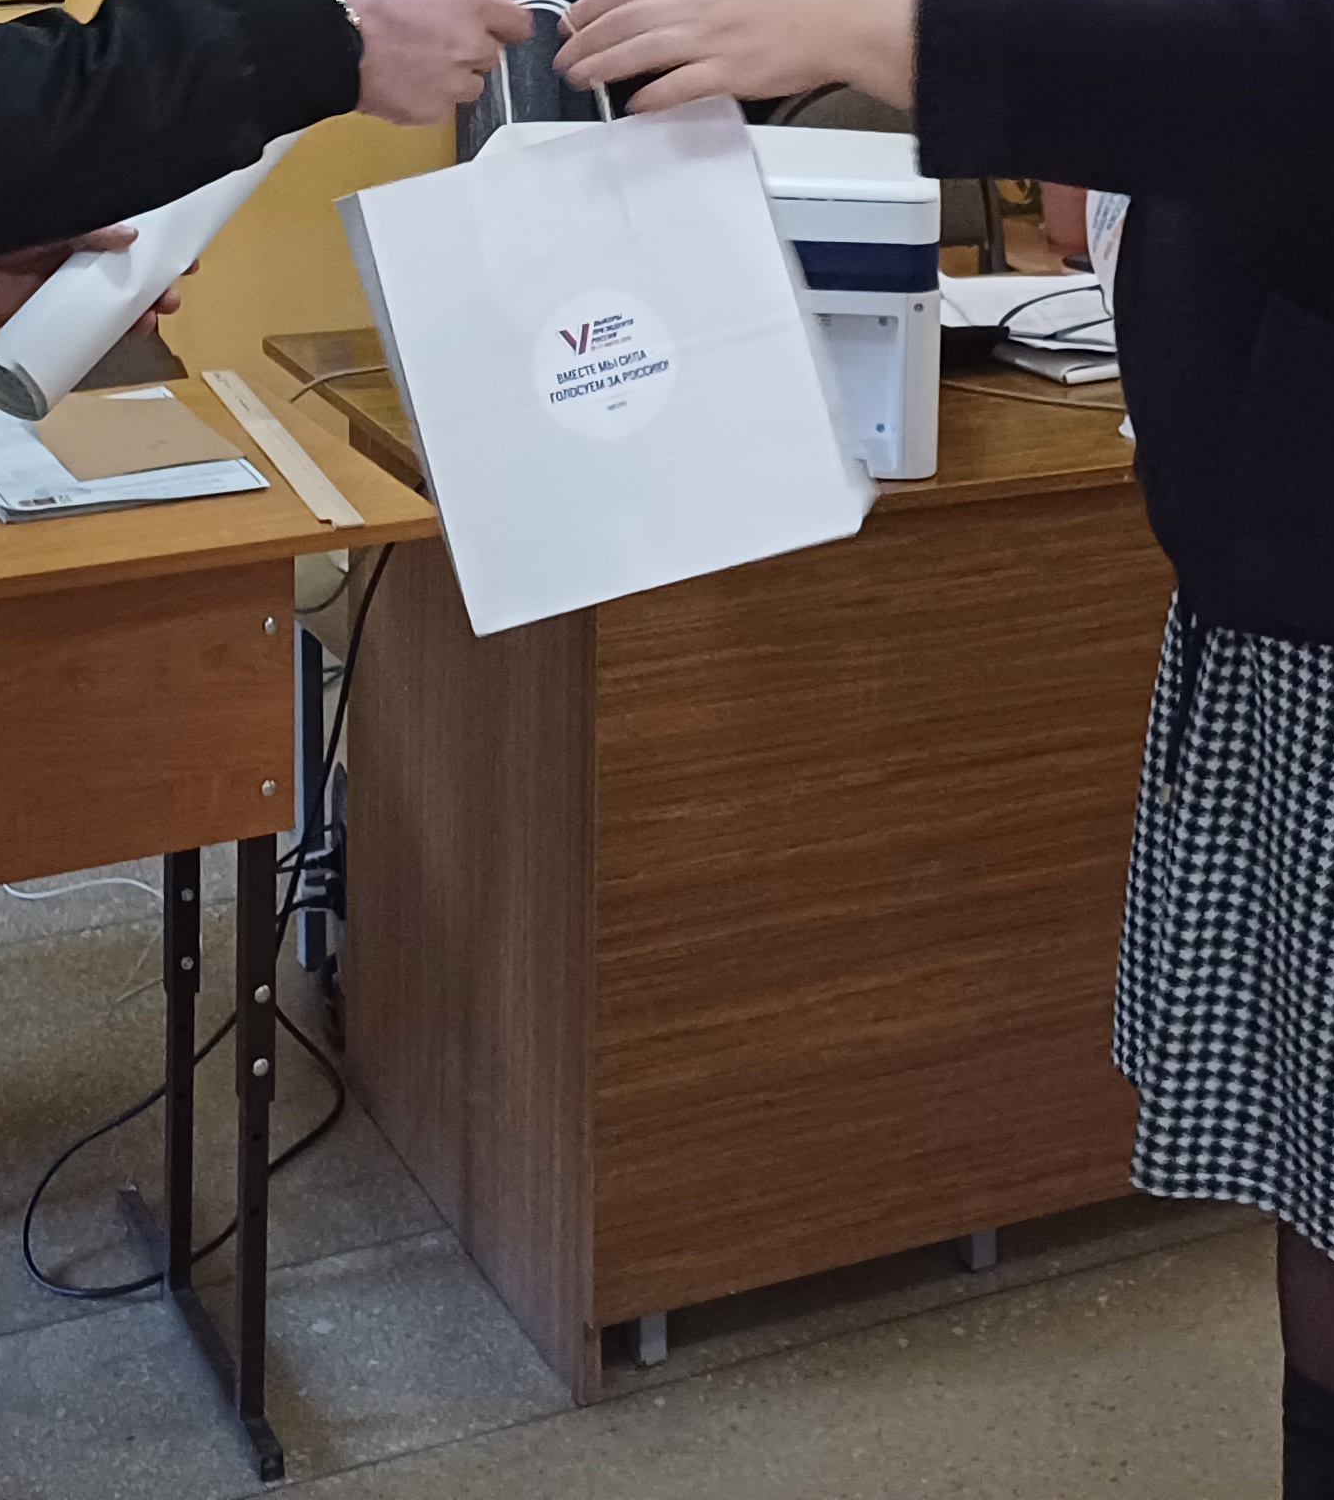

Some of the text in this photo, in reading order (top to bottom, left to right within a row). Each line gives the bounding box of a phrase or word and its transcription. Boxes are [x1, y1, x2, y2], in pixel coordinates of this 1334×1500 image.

[556, 363, 597, 385] ВМЕСТЕ
[598, 358, 619, 373] МЫ
[549, 379, 606, 404] ГОЛОСУЕМ
[606, 374, 623, 388] ЗА
